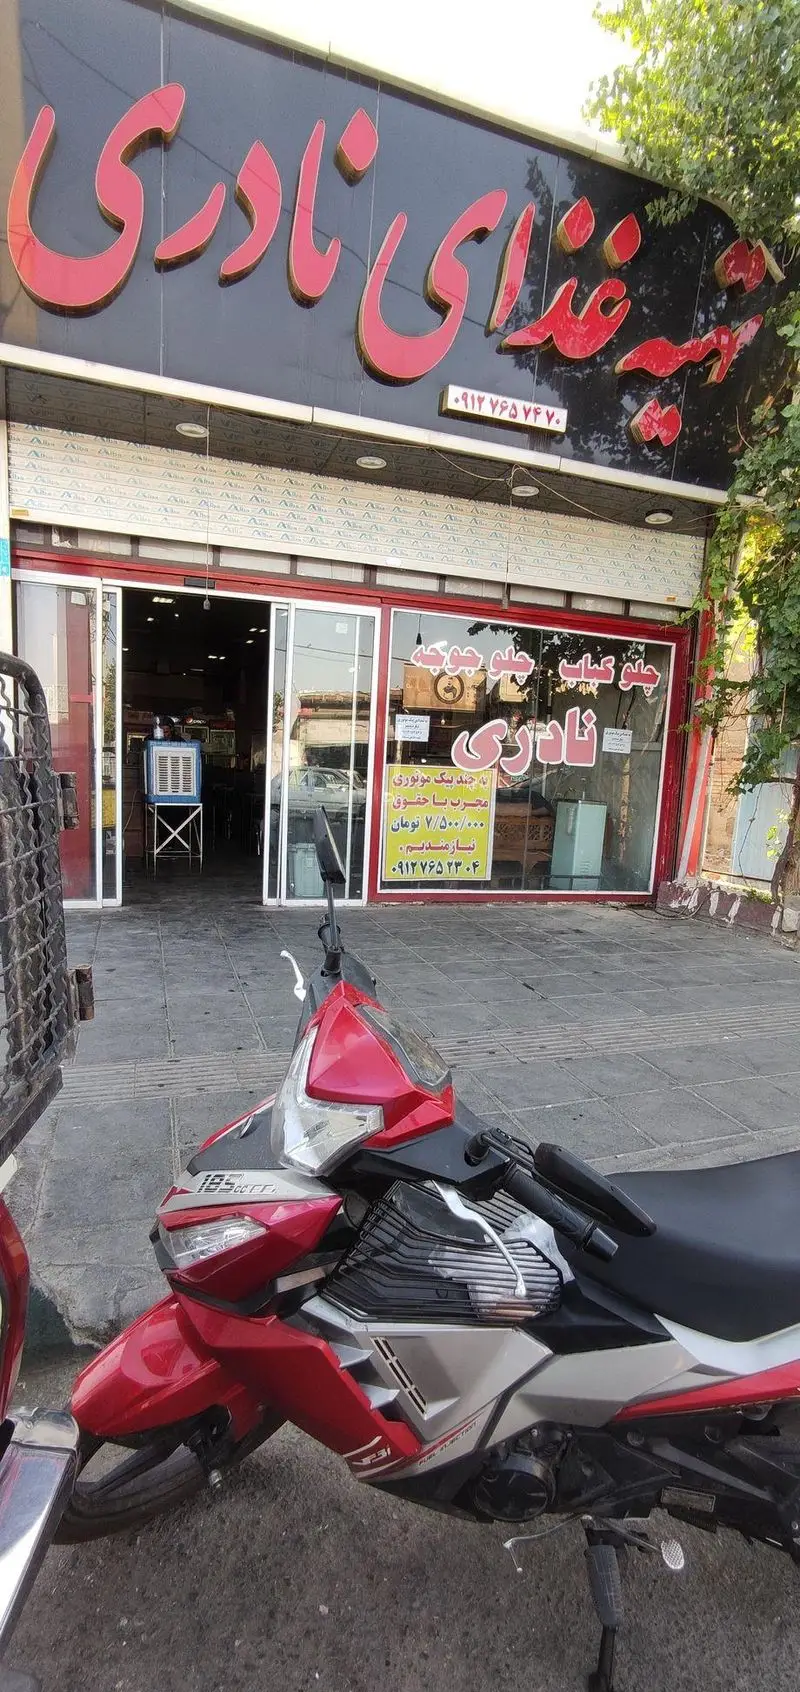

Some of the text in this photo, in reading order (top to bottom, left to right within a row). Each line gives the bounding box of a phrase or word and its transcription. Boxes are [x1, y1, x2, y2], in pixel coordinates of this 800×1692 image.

[7, 82, 767, 447] تهیه غذای نادری
[454, 392, 485, 412] ۰۹۱۲
[490, 397, 518, 420] ۷۶۵
[411, 640, 661, 698] چلو کباب چلو جوجه
[451, 706, 598, 776] نادری
[392, 770, 431, 788] موتوری
[433, 771, 454, 789] پیک
[392, 792, 489, 811] مجرب با حقوق
[391, 815, 420, 833] تومان
[392, 860, 417, 875] ۰۹۱۲
[420, 860, 443, 875] ۷۶۵
